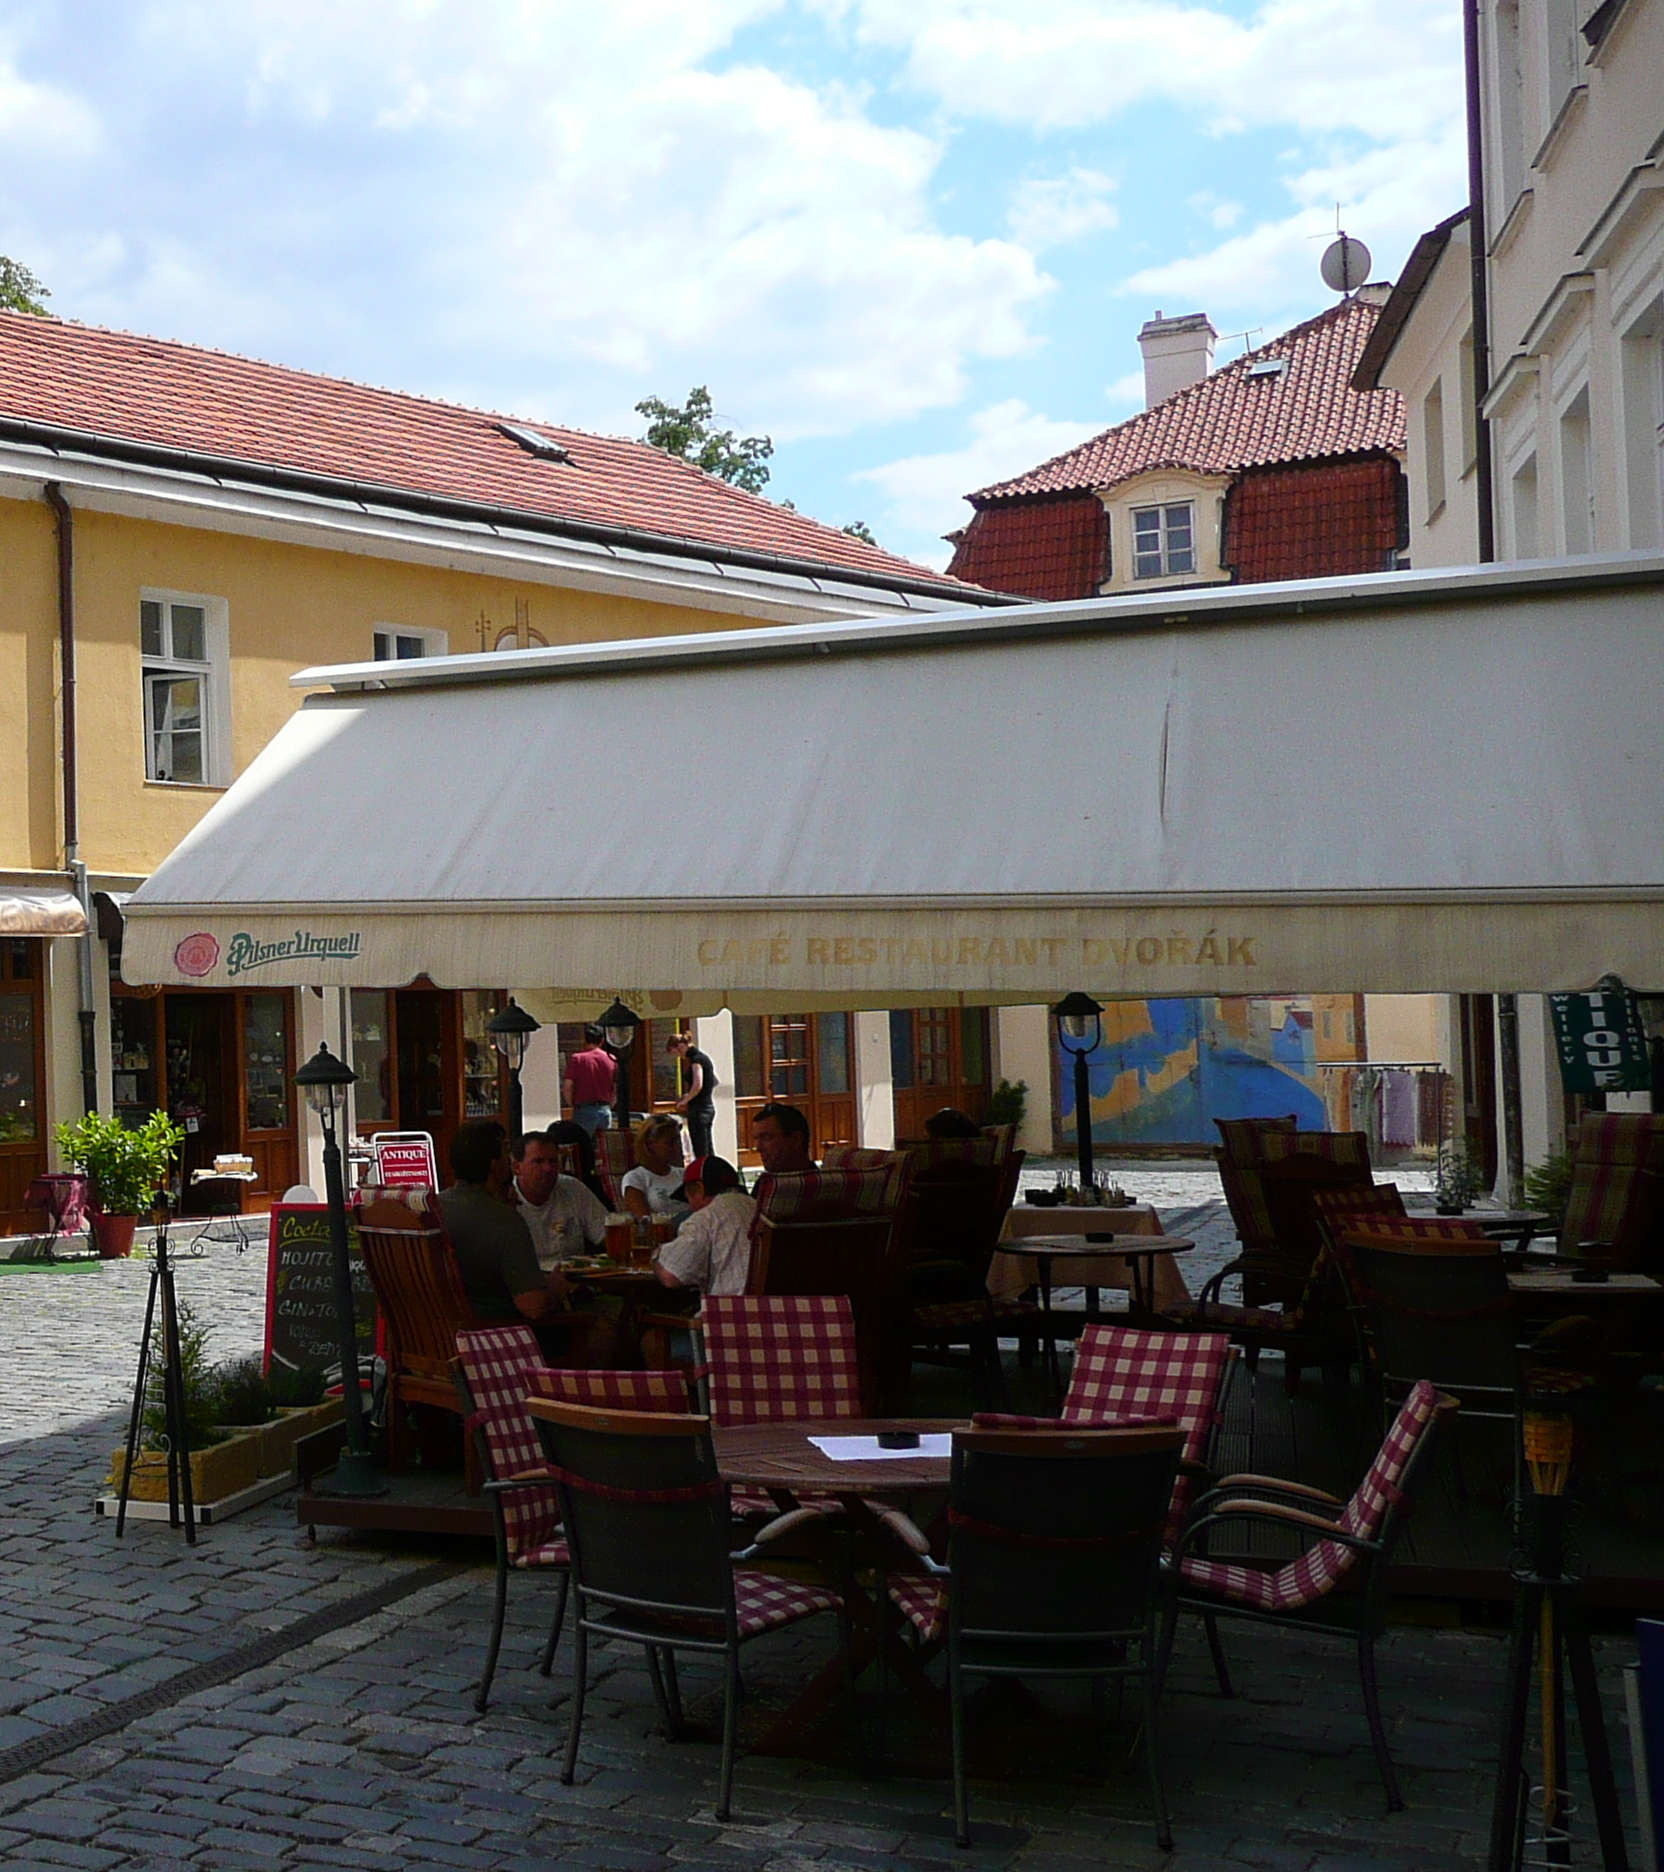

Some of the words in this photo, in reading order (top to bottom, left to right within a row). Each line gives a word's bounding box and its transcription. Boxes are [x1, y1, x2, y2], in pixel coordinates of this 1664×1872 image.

[227, 932, 296, 977] Pilsner
[295, 929, 361, 962] Urquell
[697, 931, 790, 966] CAFÉ
[806, 936, 1067, 966] RESTAURANT
[1082, 928, 1257, 966] DVOŘÁK
[383, 1150, 426, 1161] ANTIQUE
